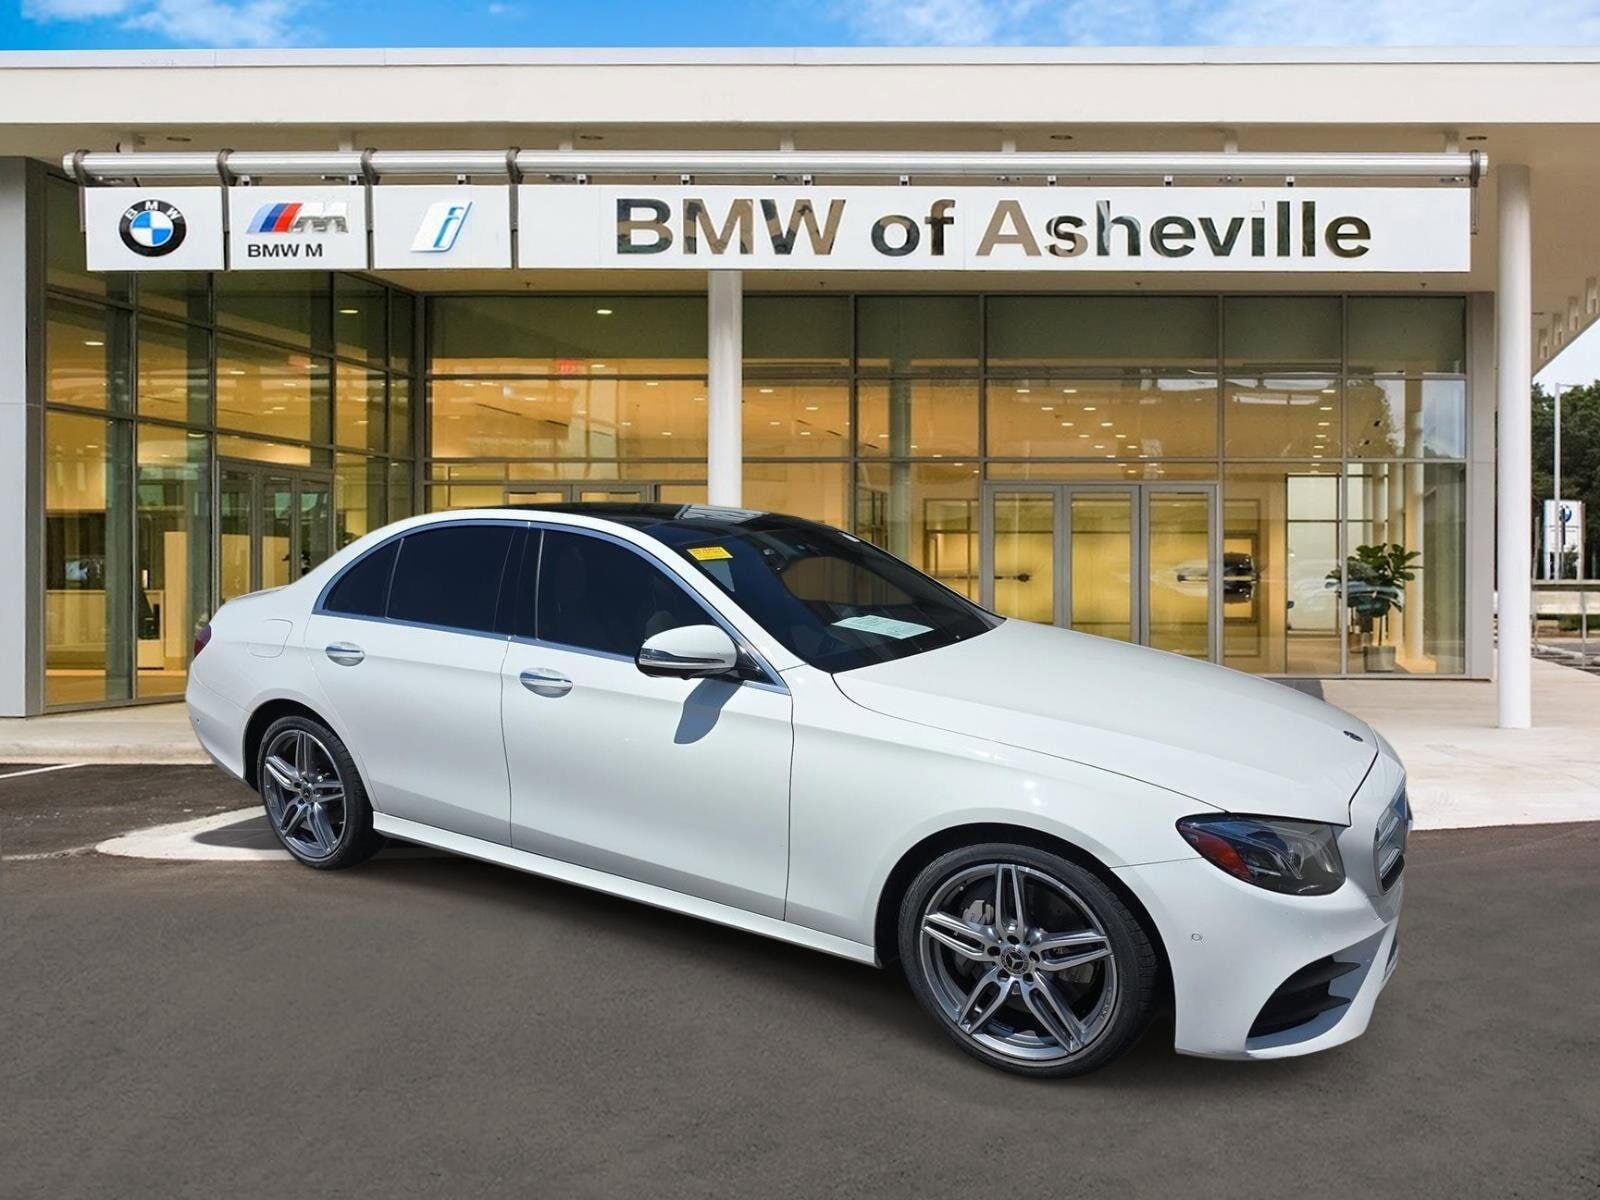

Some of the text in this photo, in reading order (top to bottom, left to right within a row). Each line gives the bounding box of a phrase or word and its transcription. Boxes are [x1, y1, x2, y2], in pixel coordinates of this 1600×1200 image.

[125, 201, 181, 220] BMW
[616, 198, 1372, 258] BMW of Asheville
[247, 243, 323, 258] BMW M
